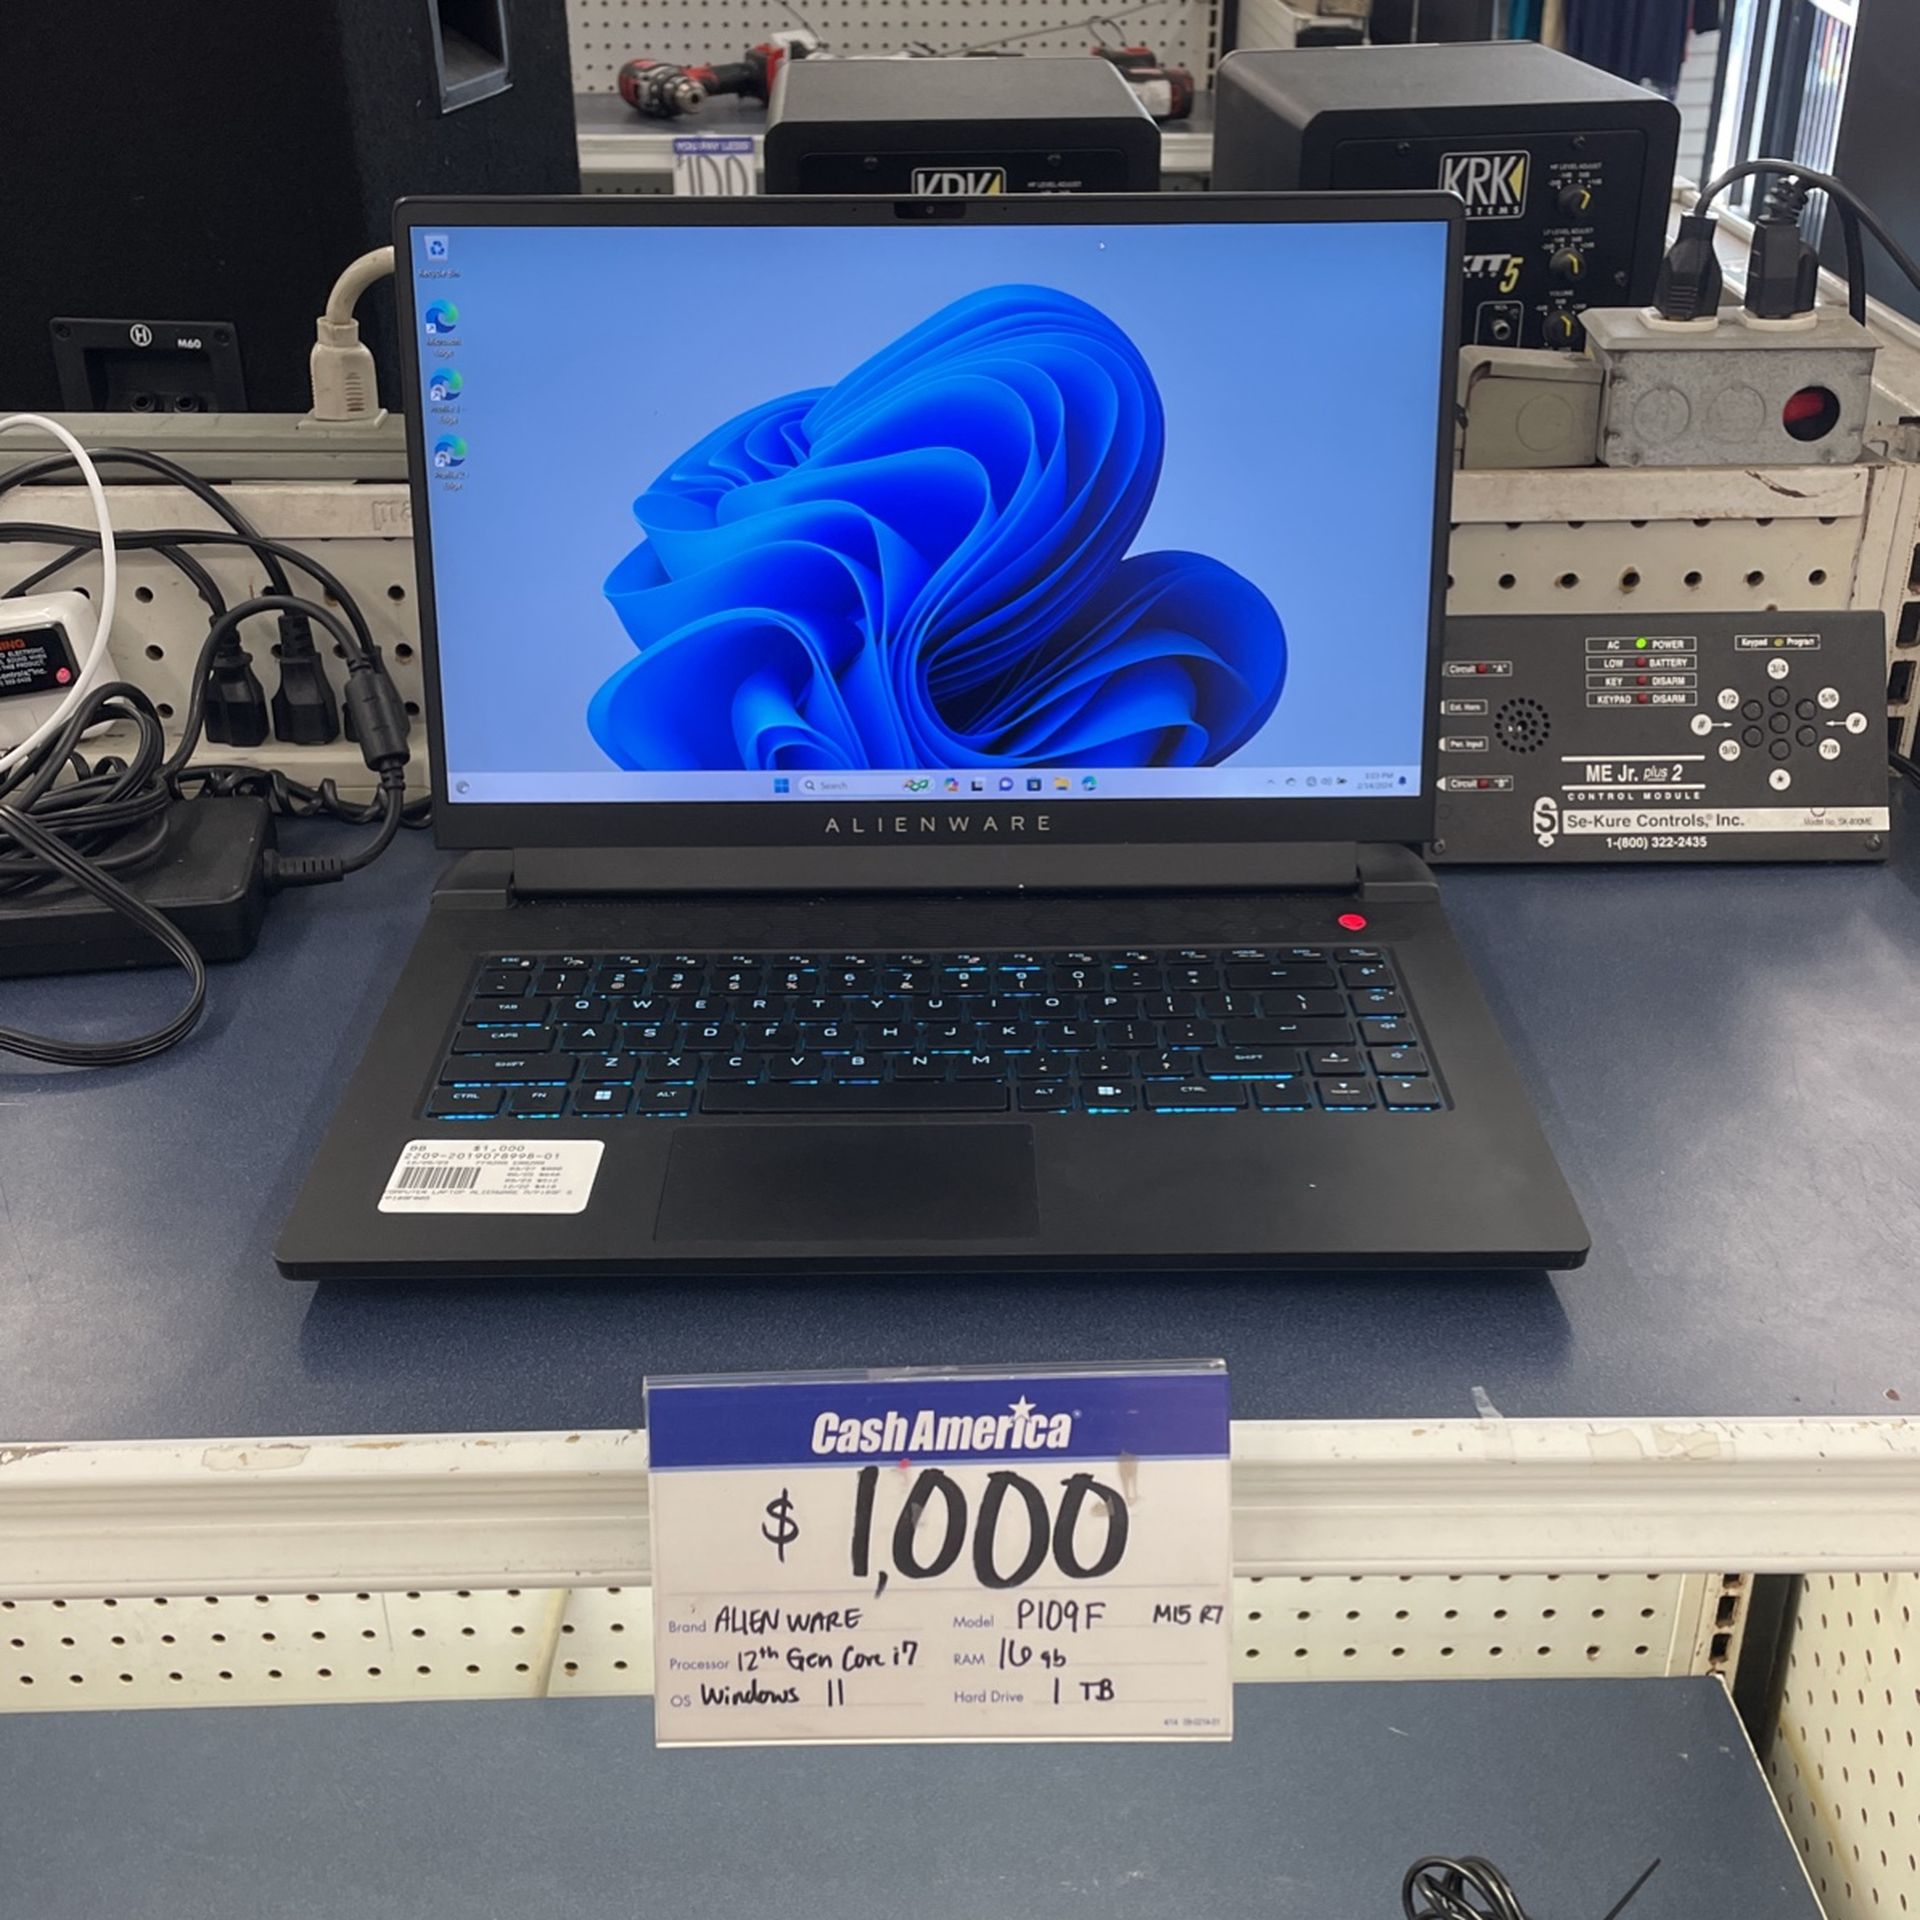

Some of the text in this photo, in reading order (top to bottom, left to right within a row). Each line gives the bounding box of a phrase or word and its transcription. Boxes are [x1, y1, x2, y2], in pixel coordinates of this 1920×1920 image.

[1444, 156, 1517, 205] KRK
[1465, 206, 1520, 216] STEMS
[1607, 640, 1684, 649] AC POWER
[1741, 637, 1815, 649] Keypad Program
[1603, 659, 1687, 668] LOW BATTERY
[1771, 663, 1786, 674] 3/4
[1605, 677, 1685, 686] KEY DISARM
[1597, 695, 1686, 704] KEYPAD DISARM
[1722, 694, 1736, 704] 1/2
[1852, 718, 1861, 728] #
[1586, 764, 1683, 782] ME Jr. plus 2
[1568, 792, 1700, 801] CONTROL MODULE
[825, 816, 1051, 833] ALIENWARE
[1567, 814, 1631, 828] Se-Kure
[1716, 814, 1745, 827] Inc.
[1606, 837, 1707, 850] 1-(800) 322-2435
[614, 974, 626, 982] 2
[672, 974, 684, 982] 3
[729, 974, 741, 982] 4
[844, 974, 856, 982] 6
[903, 973, 913, 981] 7
[1016, 972, 1027, 980] 9
[633, 1000, 652, 1009] W
[695, 1000, 707, 1009] E
[753, 1000, 766, 1008] R
[813, 1000, 825, 1008] T
[871, 1000, 883, 1008] Y
[929, 1000, 943, 1008] U
[1046, 998, 1059, 1007] O
[1105, 997, 1117, 1006] P
[582, 1028, 596, 1037] A
[644, 1028, 657, 1037] S
[704, 1028, 718, 1037] D
[765, 1028, 777, 1037] F
[824, 1028, 838, 1037] G
[883, 1028, 898, 1037] H
[945, 1027, 956, 1036] J
[1003, 1026, 1016, 1035] K
[1064, 1026, 1076, 1035] L
[605, 1057, 619, 1067] Z
[667, 1057, 681, 1067] X
[729, 1057, 742, 1067] C
[791, 1057, 804, 1066] V
[851, 1056, 865, 1066] B
[913, 1056, 928, 1065] N
[972, 1056, 990, 1065] M
[474, 1145, 525, 1153] $1,000
[811, 1397, 1072, 1454] Cash America
[762, 1465, 1129, 1598] $ 1,000
[953, 1616, 994, 1628] Model
[1152, 1603, 1193, 1625] M15
[1199, 1605, 1224, 1625] R7
[669, 1620, 707, 1634] Brand
[669, 1641, 918, 1672] Processor 12th Gen Core i7
[953, 1654, 985, 1665] RAM
[999, 1637, 1032, 1670] 16
[670, 1678, 844, 1708] OS Windows 11
[954, 1677, 1115, 1705] Hard Drive 1 TB
